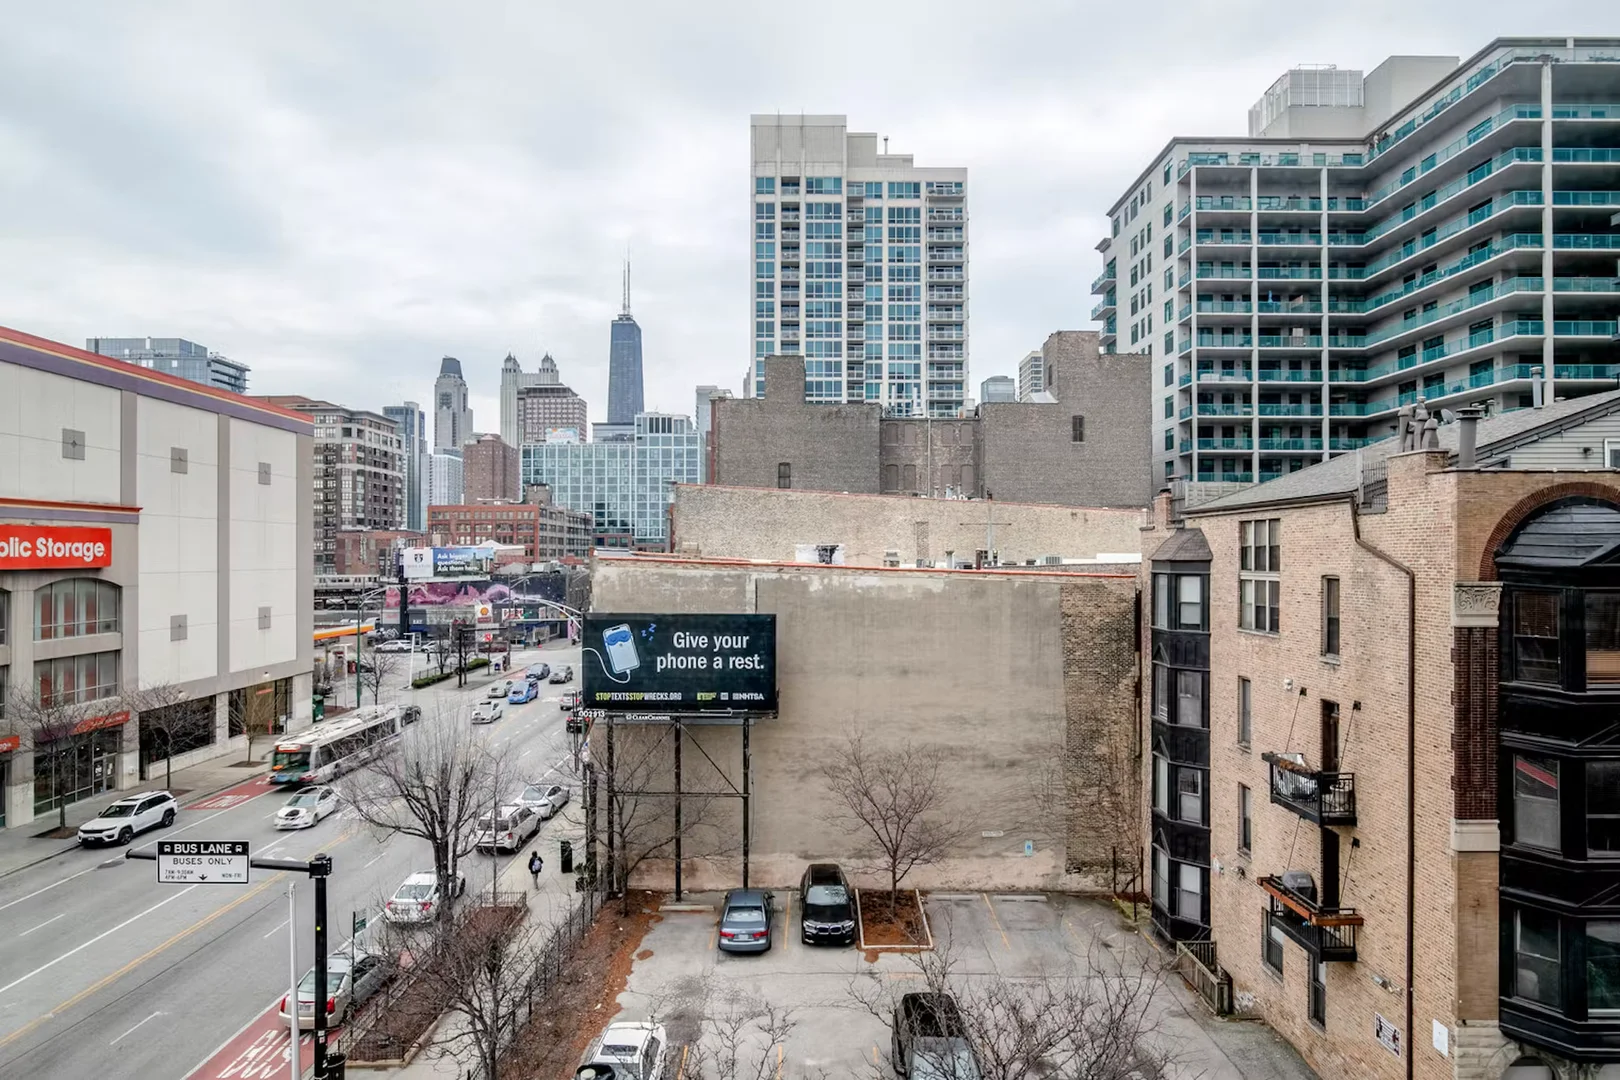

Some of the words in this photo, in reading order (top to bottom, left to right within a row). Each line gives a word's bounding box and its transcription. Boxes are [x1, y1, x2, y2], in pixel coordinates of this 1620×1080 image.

[673, 631, 708, 648] Give
[713, 635, 750, 652] your
[656, 652, 707, 673] phone
[713, 656, 722, 669] a
[729, 653, 764, 669] rest.
[595, 692, 682, 701] STOPTEXTSSTOPWRECKS.ORG
[739, 692, 765, 700] NHTSA
[578, 710, 605, 718] 002913
[173, 843, 198, 854] BUS
[200, 843, 232, 854] LANE
[172, 857, 203, 865] BUSES
[207, 857, 233, 865] ONLY
